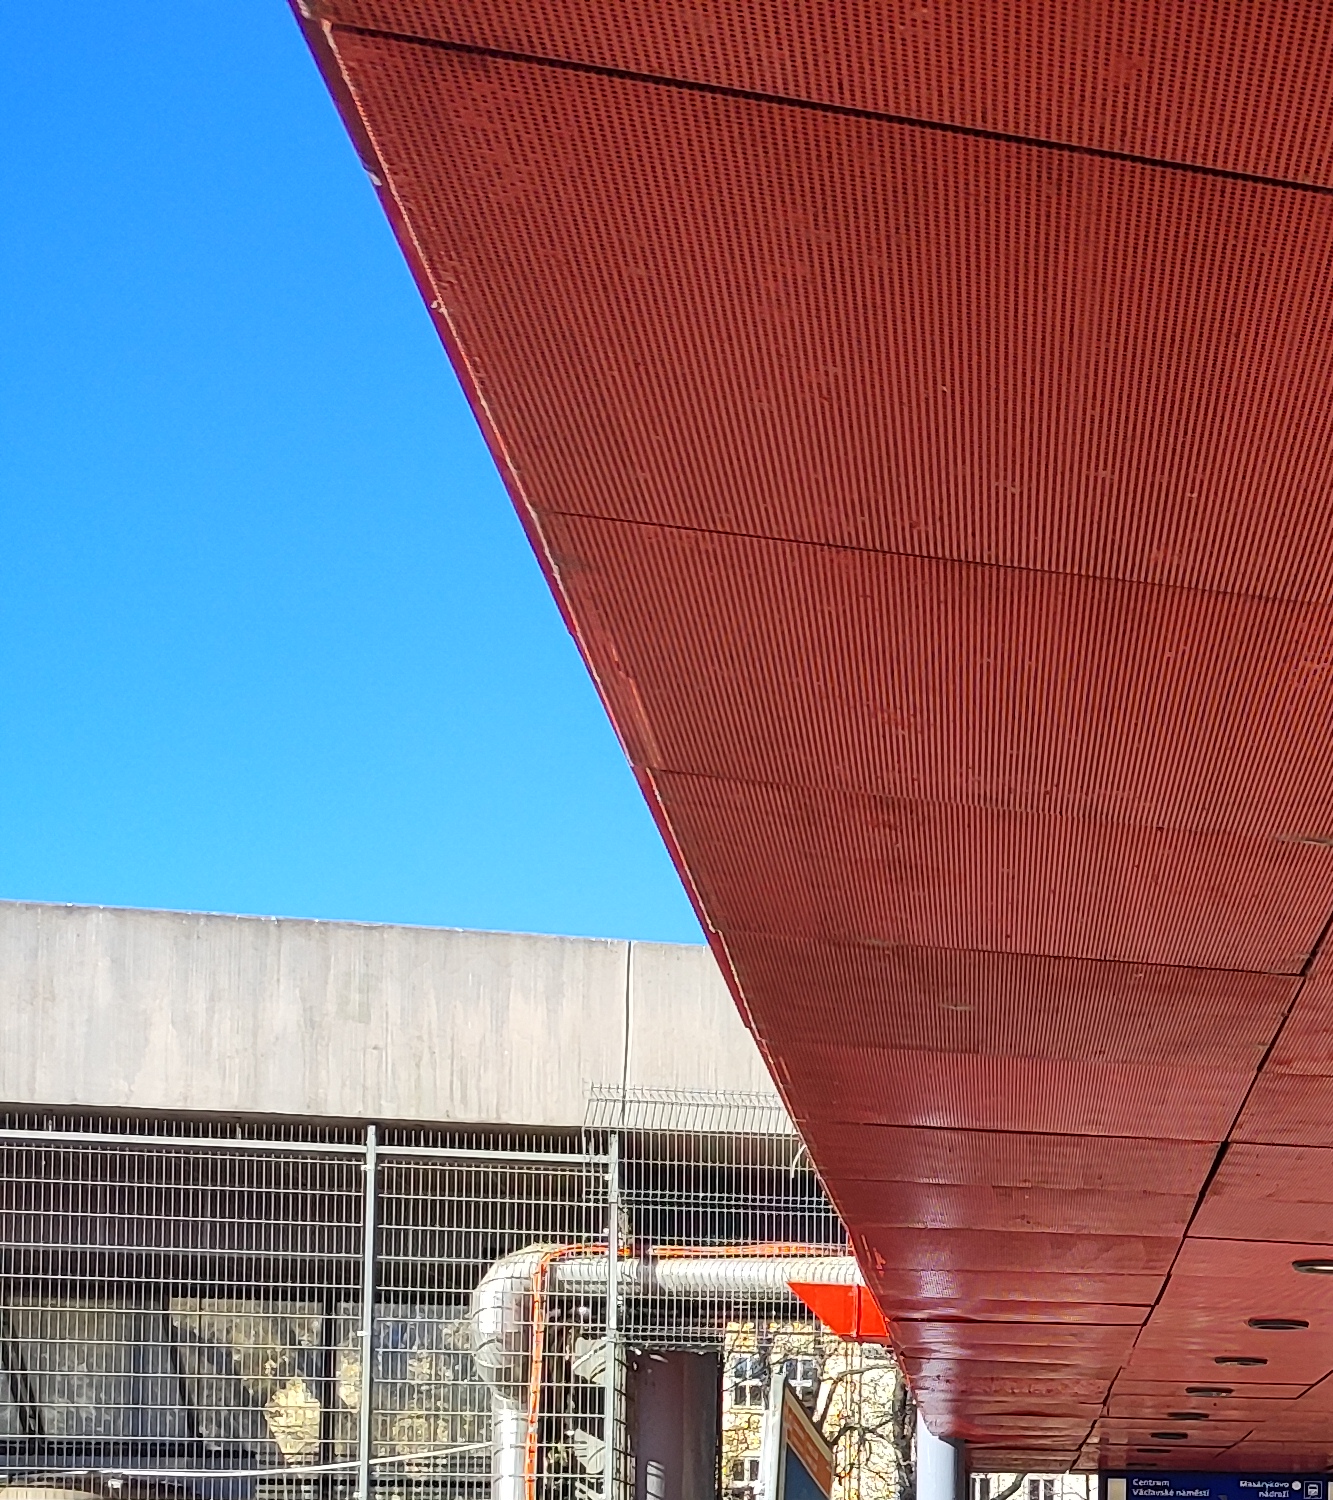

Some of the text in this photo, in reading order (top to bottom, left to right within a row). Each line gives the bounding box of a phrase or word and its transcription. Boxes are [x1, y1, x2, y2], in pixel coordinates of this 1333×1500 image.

[1132, 1478, 1170, 1486] Centrum
[1131, 1488, 1210, 1497] Václavské náměstí
[1258, 1489, 1289, 1497] nádraží
